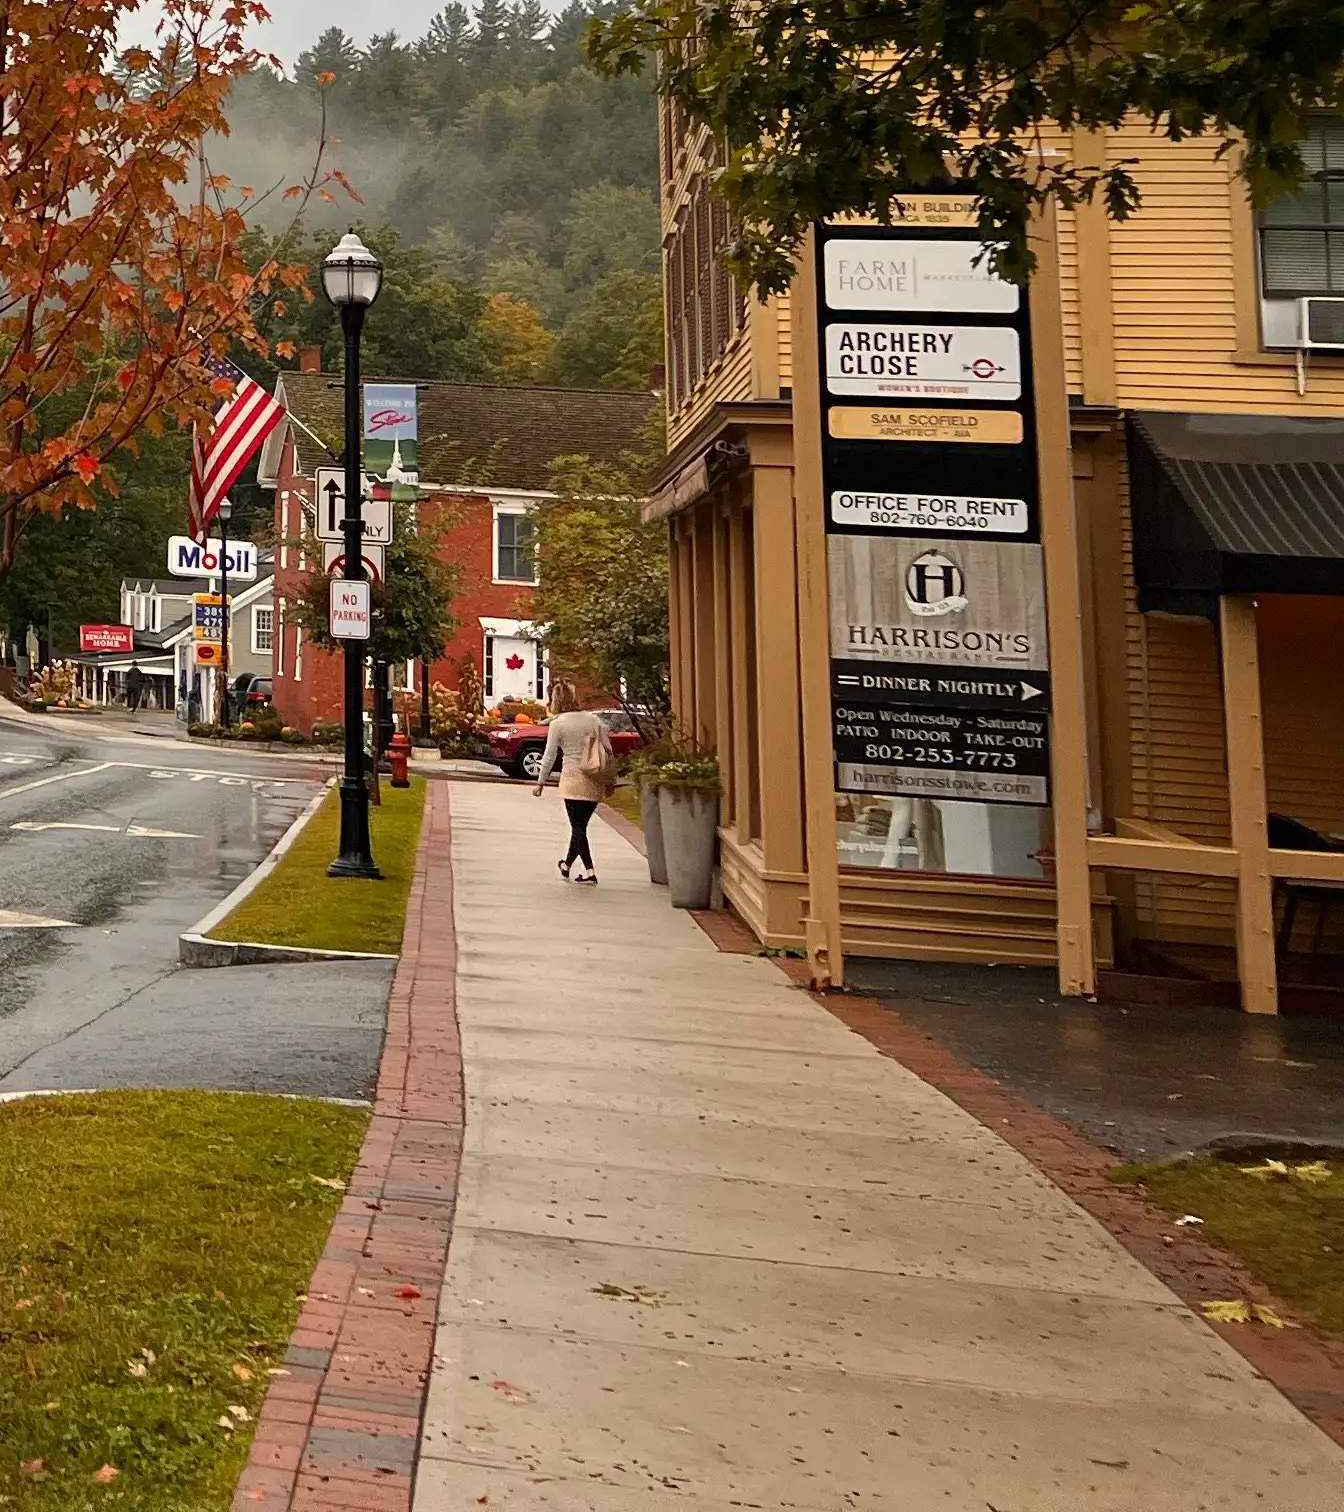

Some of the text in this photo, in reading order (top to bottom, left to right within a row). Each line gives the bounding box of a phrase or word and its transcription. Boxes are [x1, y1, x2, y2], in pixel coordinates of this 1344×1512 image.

[923, 202, 978, 213] BUILDIN
[838, 260, 907, 276] FARM
[838, 276, 908, 292] HOME
[838, 331, 953, 353] ARCHERY
[839, 354, 919, 376] CLOSE
[870, 413, 979, 426] SAM SCOFIELD
[839, 494, 1020, 517] OFFICE FOR RENT
[869, 511, 989, 529] 802-760-6040
[362, 525, 384, 538] NLY
[177, 544, 250, 573] Mobil
[912, 563, 957, 604] H
[342, 593, 358, 606] NO
[332, 609, 368, 622] PARKING
[92, 639, 121, 647] HOME
[848, 625, 1031, 654] HARRISON'S
[862, 675, 1018, 697] DINNER NIGHTLY
[835, 707, 875, 722] Open
[879, 709, 962, 729] Wednesday
[976, 716, 1043, 734] Saturday
[836, 724, 1045, 749] PATIO INDOOR TAKE-OUT
[865, 744, 1017, 768] 802-253-7773
